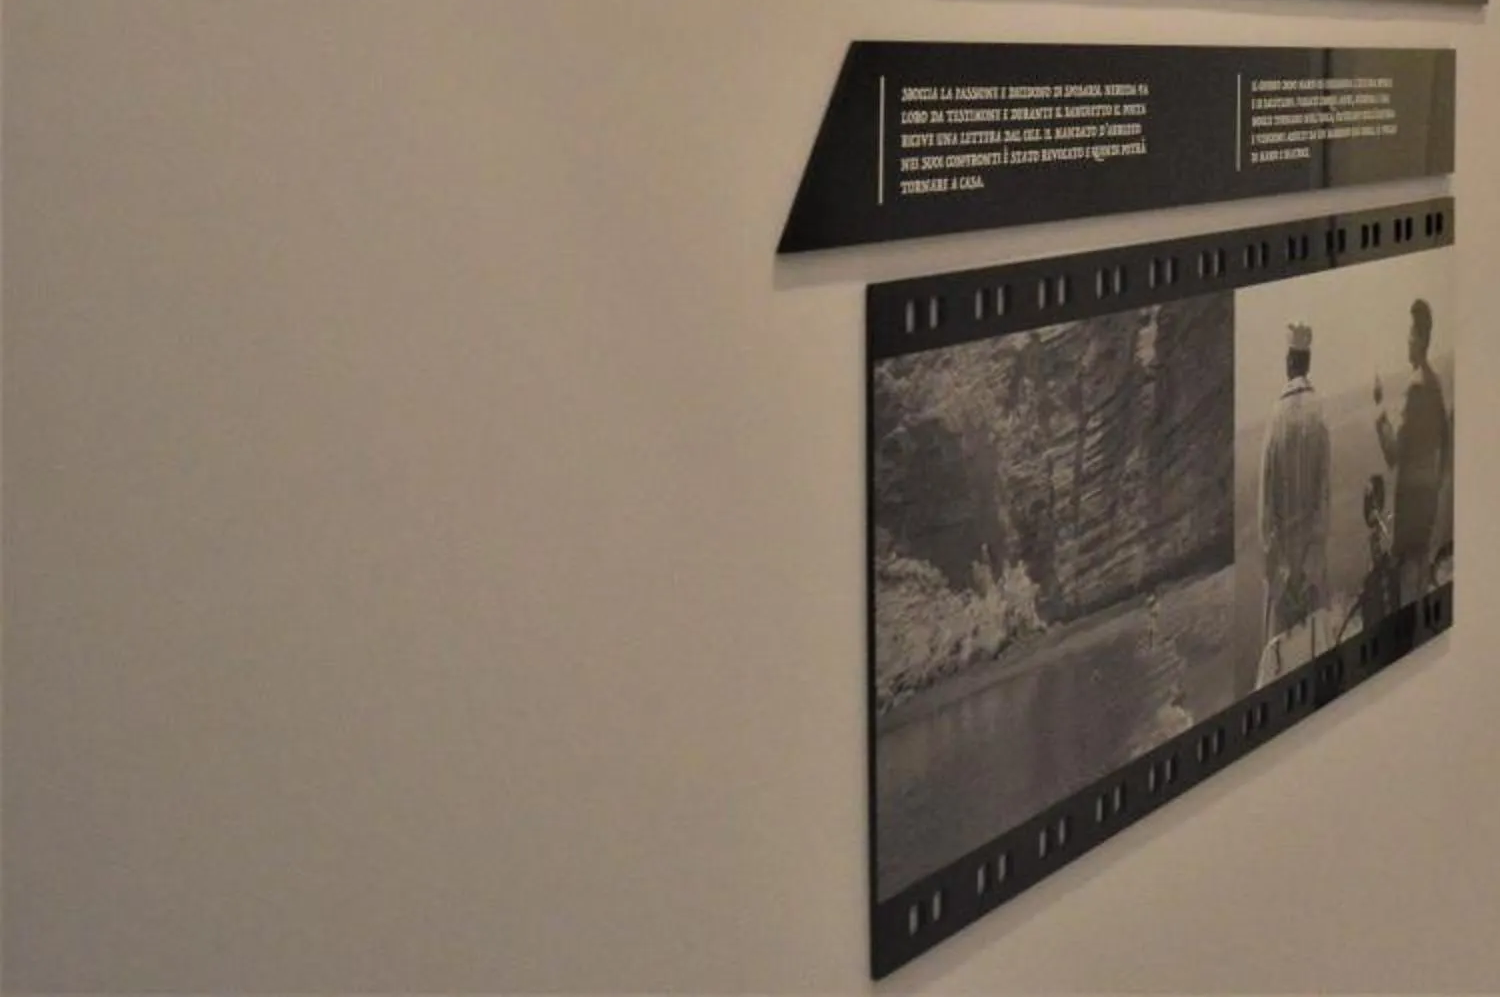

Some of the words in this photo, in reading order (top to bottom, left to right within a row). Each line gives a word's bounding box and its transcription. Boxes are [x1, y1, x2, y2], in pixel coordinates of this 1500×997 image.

[940, 86, 953, 101] LA
[956, 86, 998, 100] PASSIONE
[901, 110, 928, 124] LORO
[930, 110, 944, 123] DA
[946, 108, 1001, 124] TESTIMONE
[1010, 107, 1053, 120] DURANTE
[936, 132, 958, 146] UNA
[960, 131, 1001, 144] LETTERA
[1054, 126, 1097, 140] MANDATO
[946, 152, 1001, 168] CONFRONTI
[1010, 150, 1040, 164] STATO
[900, 178, 948, 194] TORNARE
